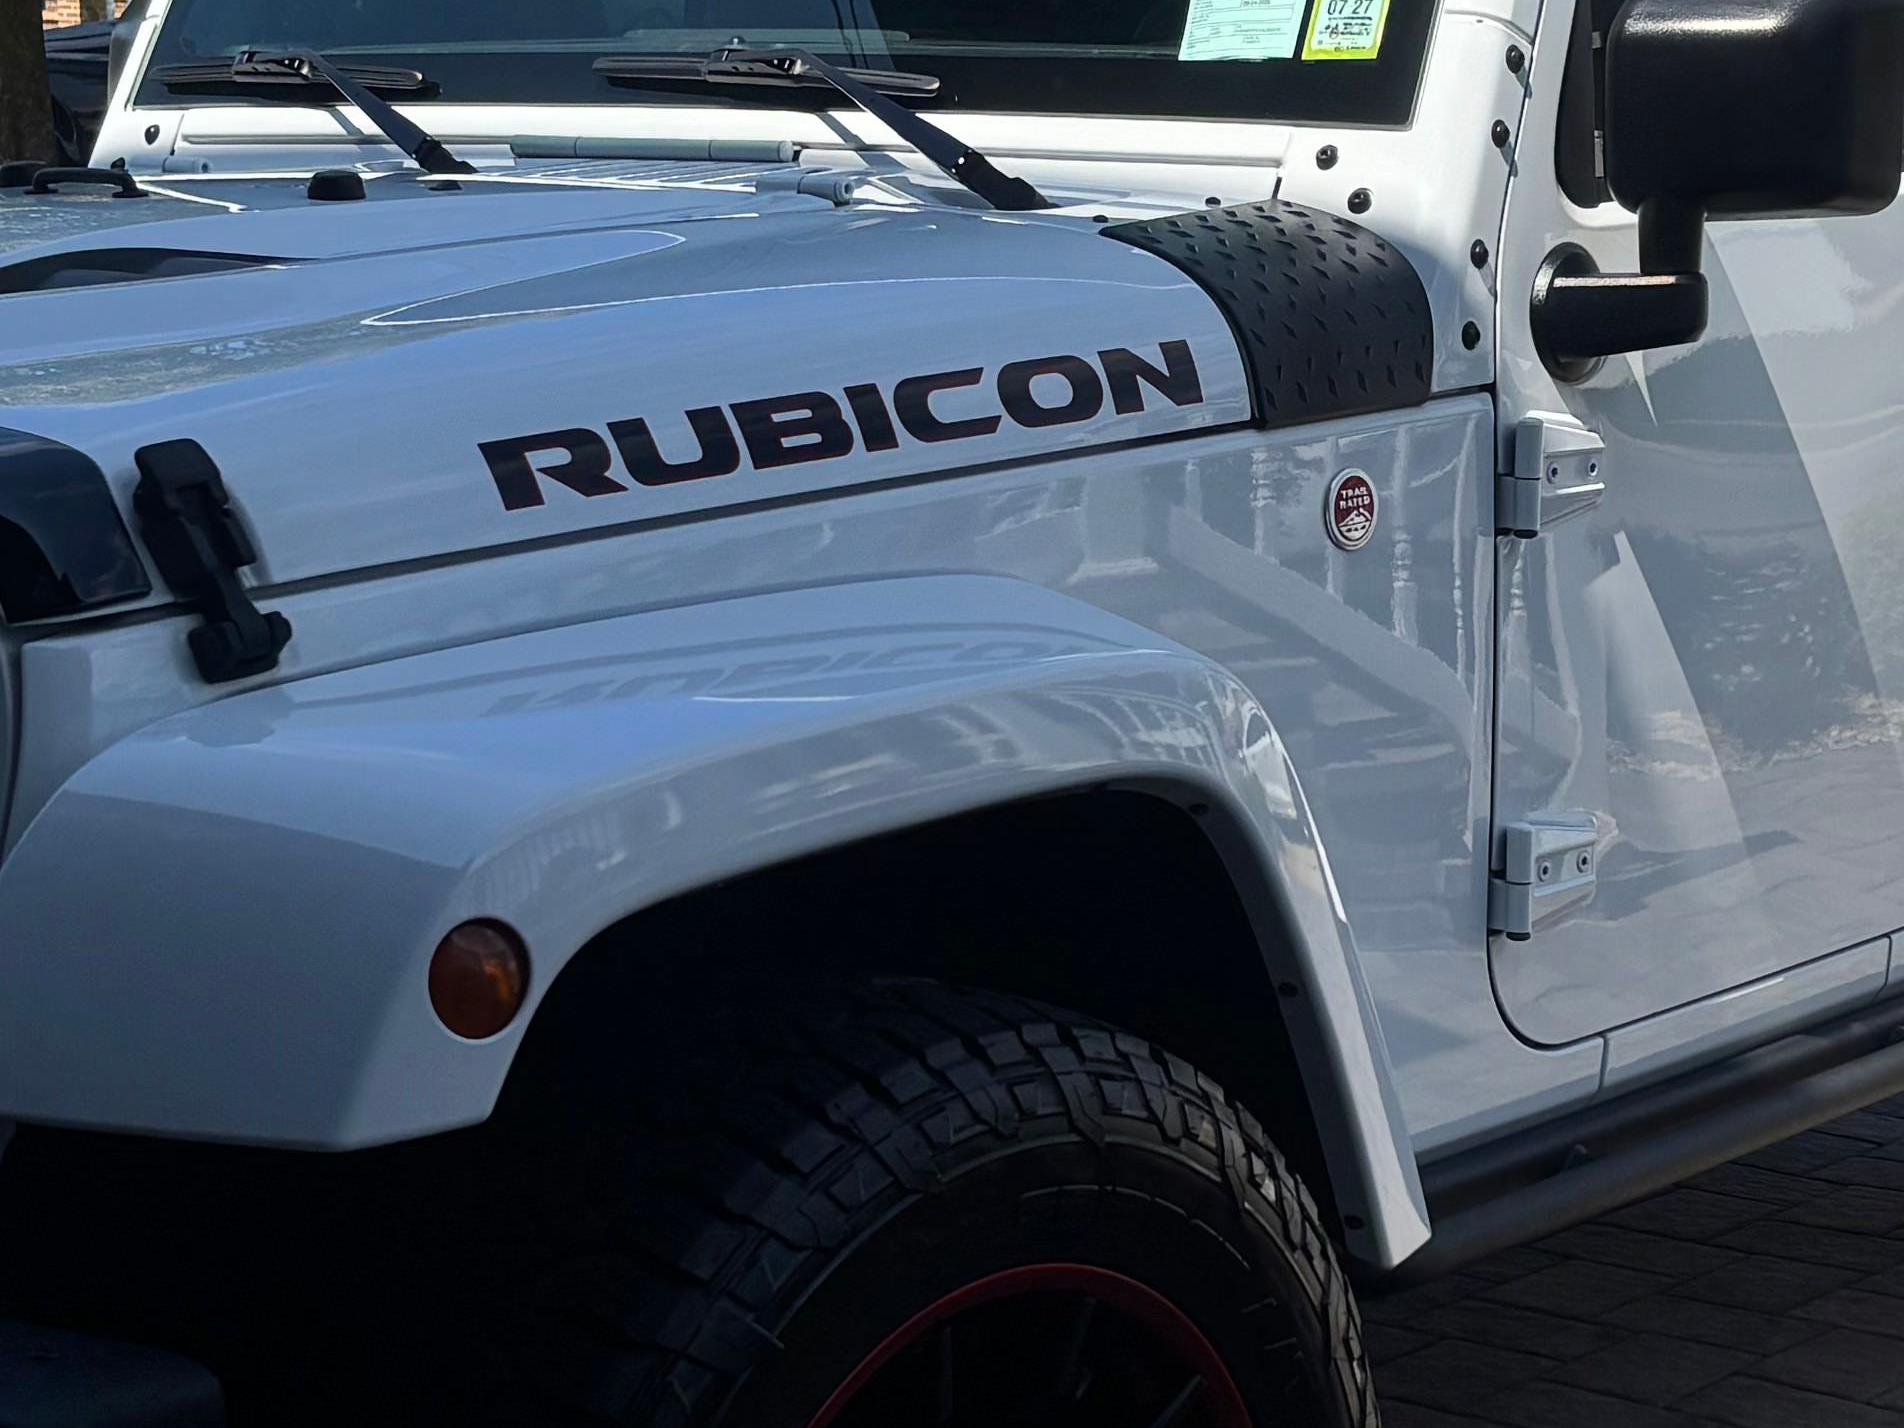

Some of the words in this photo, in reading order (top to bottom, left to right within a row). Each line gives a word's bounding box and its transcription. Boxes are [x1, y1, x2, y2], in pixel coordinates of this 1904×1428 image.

[1327, 0, 1348, 15] 07
[477, 339, 1205, 511] RUBICON
[1340, 486, 1368, 499] TRAIL
[1339, 496, 1370, 509] RATED
